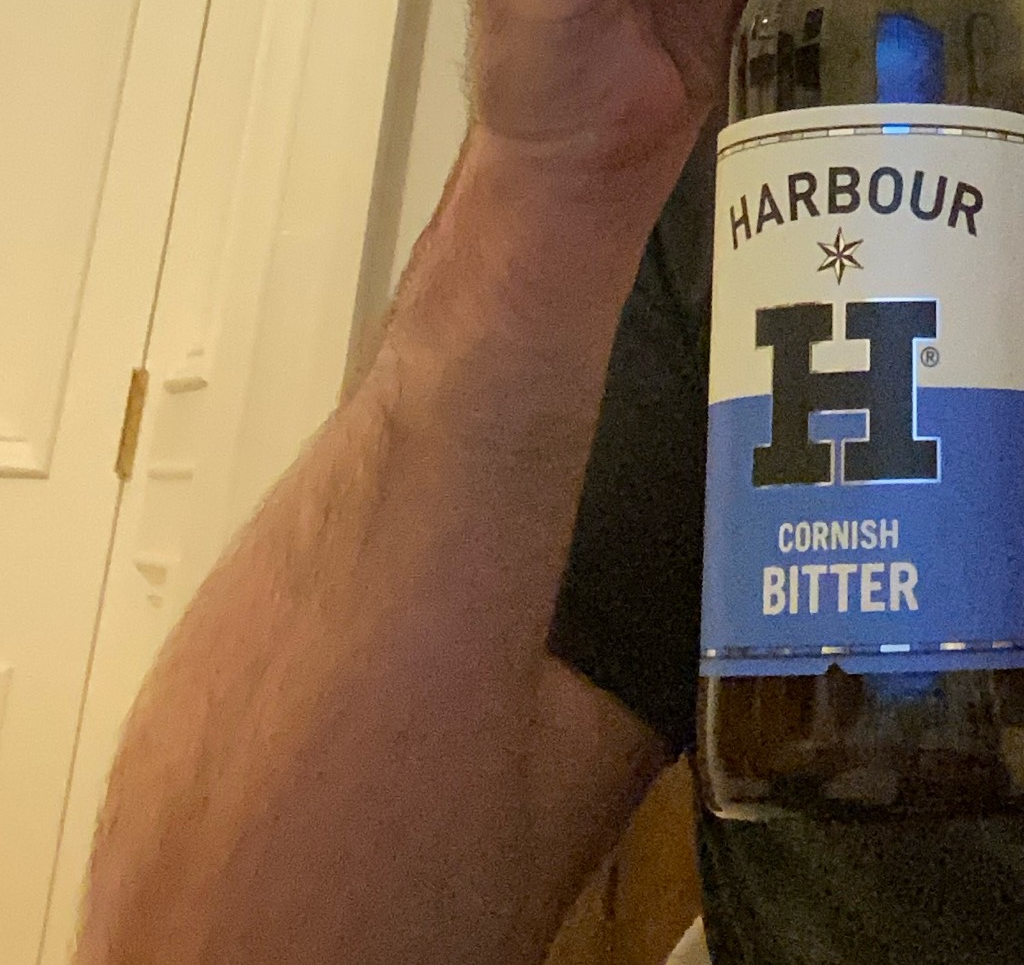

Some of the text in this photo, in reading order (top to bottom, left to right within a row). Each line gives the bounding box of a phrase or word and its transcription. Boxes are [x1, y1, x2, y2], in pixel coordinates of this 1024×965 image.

[730, 166, 984, 249] HARBOUR
[753, 300, 939, 486] H
[778, 518, 900, 553] CORNISH
[762, 562, 919, 616] BITTER
